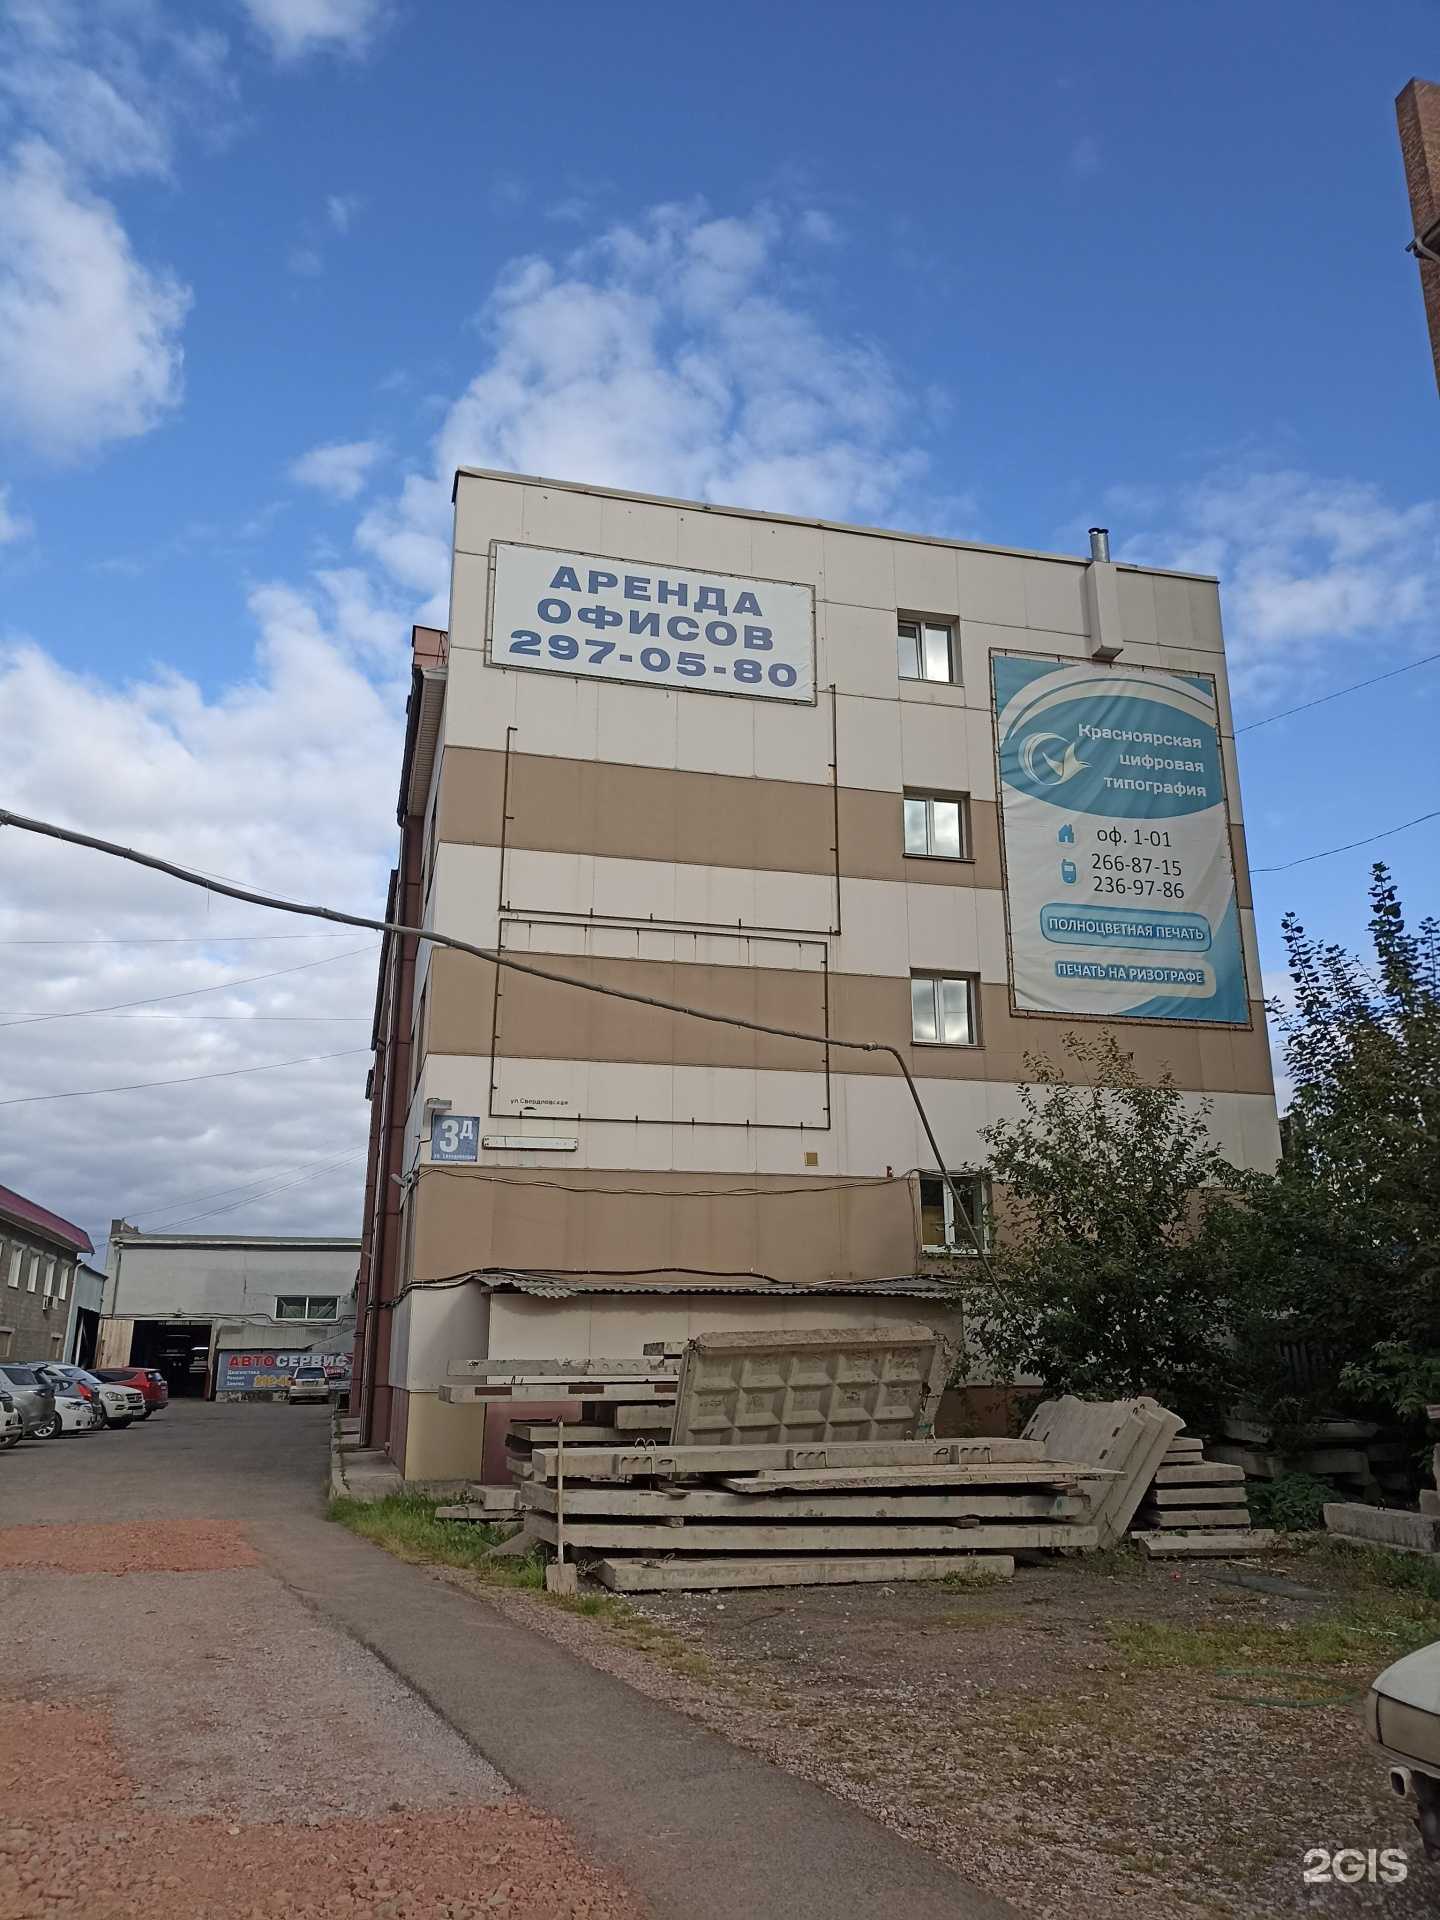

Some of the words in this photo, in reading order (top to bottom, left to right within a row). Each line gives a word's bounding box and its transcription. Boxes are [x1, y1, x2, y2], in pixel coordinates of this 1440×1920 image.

[549, 565, 763, 616] АРЕНДА
[536, 598, 774, 651] ОФИСОВ
[508, 629, 798, 688] 297-05-80
[1078, 724, 1202, 749] Красноярская
[1119, 753, 1205, 773] цифровая
[1103, 777, 1207, 798] типография
[1097, 826, 1127, 846] оф.
[1134, 828, 1172, 848] 1-01
[1091, 853, 1182, 877] 266-87-15
[1093, 876, 1185, 899] 236-97-86
[1049, 917, 1153, 937] ПОЛНОЦВЕТНАЯ
[1156, 926, 1204, 940] ПЕЧАТЬ
[1057, 962, 1106, 977] ПЕЧАТЬ
[1109, 967, 1126, 979] НА
[1129, 968, 1204, 984] РИЗОГРАФЕ
